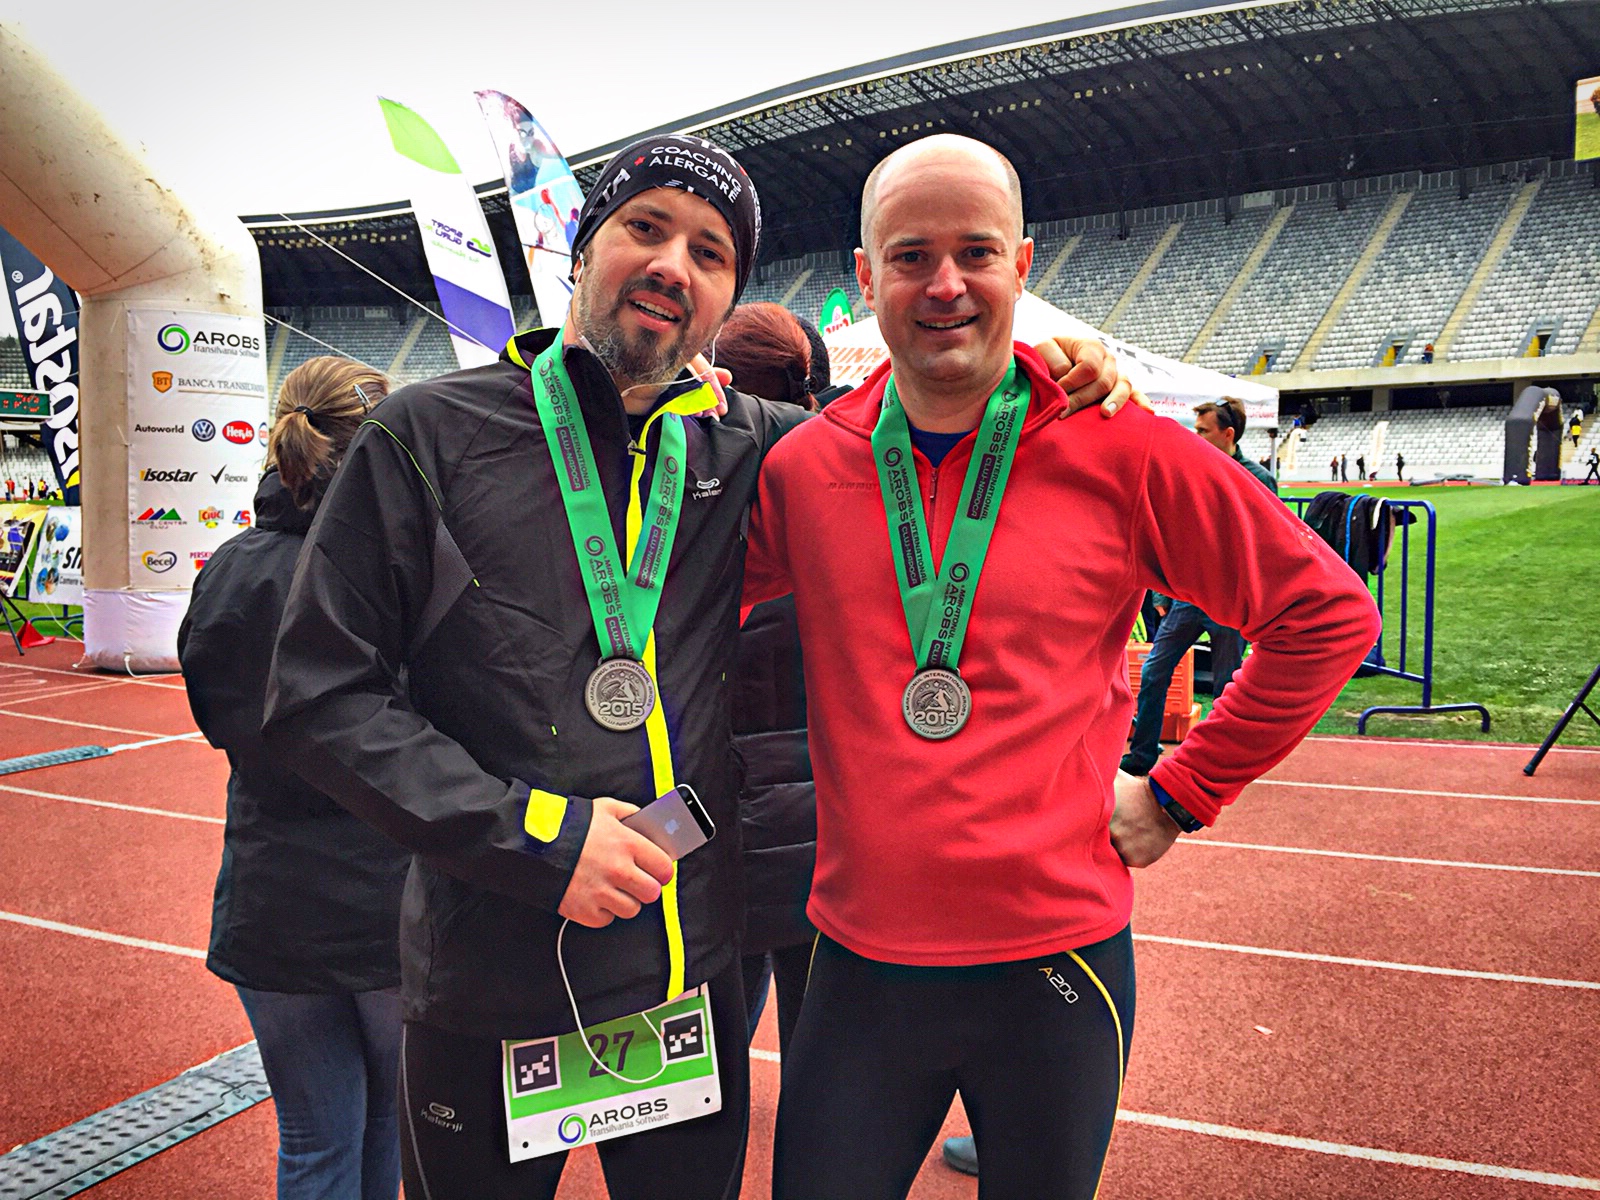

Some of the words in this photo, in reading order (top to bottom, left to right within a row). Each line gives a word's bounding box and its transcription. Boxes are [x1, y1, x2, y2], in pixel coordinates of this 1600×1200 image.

[649, 156, 740, 203] ALERGARE
[650, 146, 742, 191] COACHING
[193, 331, 260, 351] AROBS
[178, 378, 215, 388] BANCA
[134, 424, 185, 434] Autoworld
[226, 426, 253, 440] Hervis
[545, 377, 567, 425] AROBS
[559, 429, 581, 488] CLUJ-NAPOCA
[989, 403, 1011, 454] AROBS
[1001, 405, 1019, 453] MARATONUL
[144, 468, 198, 482] isostar
[568, 419, 591, 488] INTERNATIONAL
[224, 474, 248, 483] Rexona
[656, 473, 673, 526] AROBS
[972, 457, 992, 517] CLUJ-NAPOCA
[982, 454, 1005, 521] INTERNATIONAL
[892, 470, 908, 522] AROBS
[902, 526, 917, 584] CLUJ-NAPOCA
[902, 468, 914, 518] MARATONUL
[911, 518, 927, 583] INTERNATIONAL
[147, 557, 172, 566] Becel
[648, 528, 668, 589] INTERNATIONAL
[593, 559, 616, 616] AROBS
[606, 559, 622, 612] MARATONUL
[619, 612, 634, 656] INTERNAT
[938, 585, 959, 639] AROBS
[951, 589, 966, 640] MARATONUL
[599, 702, 644, 717] 2015
[914, 711, 958, 725] 2015
[1038, 967, 1079, 1004] A200
[588, 1030, 635, 1078] 27
[589, 1098, 669, 1128] AROBS
[589, 1120, 634, 1138] Transilvania
[635, 1112, 670, 1127] Software
